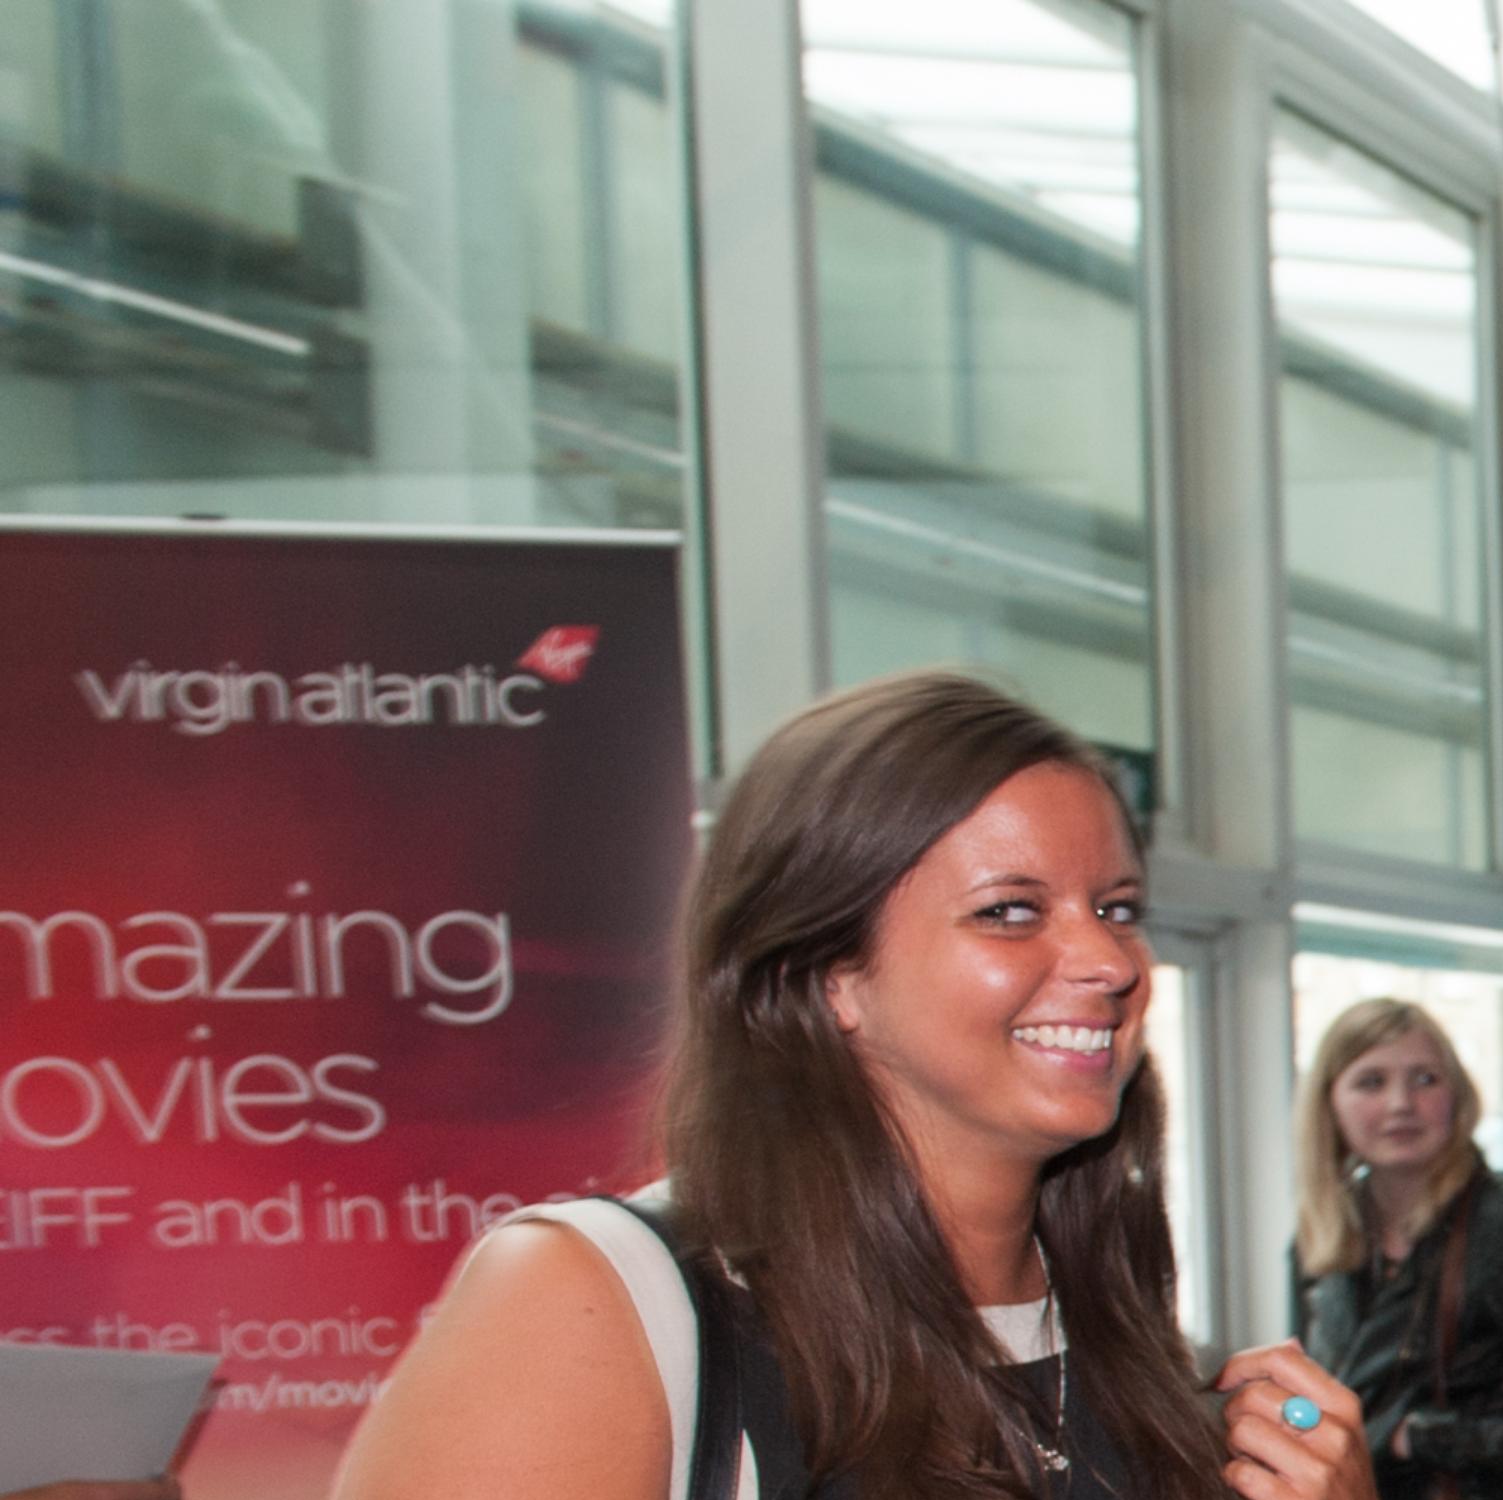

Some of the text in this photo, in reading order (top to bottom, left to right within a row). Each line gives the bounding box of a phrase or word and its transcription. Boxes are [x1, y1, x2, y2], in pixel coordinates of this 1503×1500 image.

[78, 661, 546, 735] virgin atlantic
[0, 1024, 386, 1146] ovies
[154, 1180, 306, 1249] and
[324, 1181, 388, 1244] in
[218, 1304, 397, 1361] iconic
